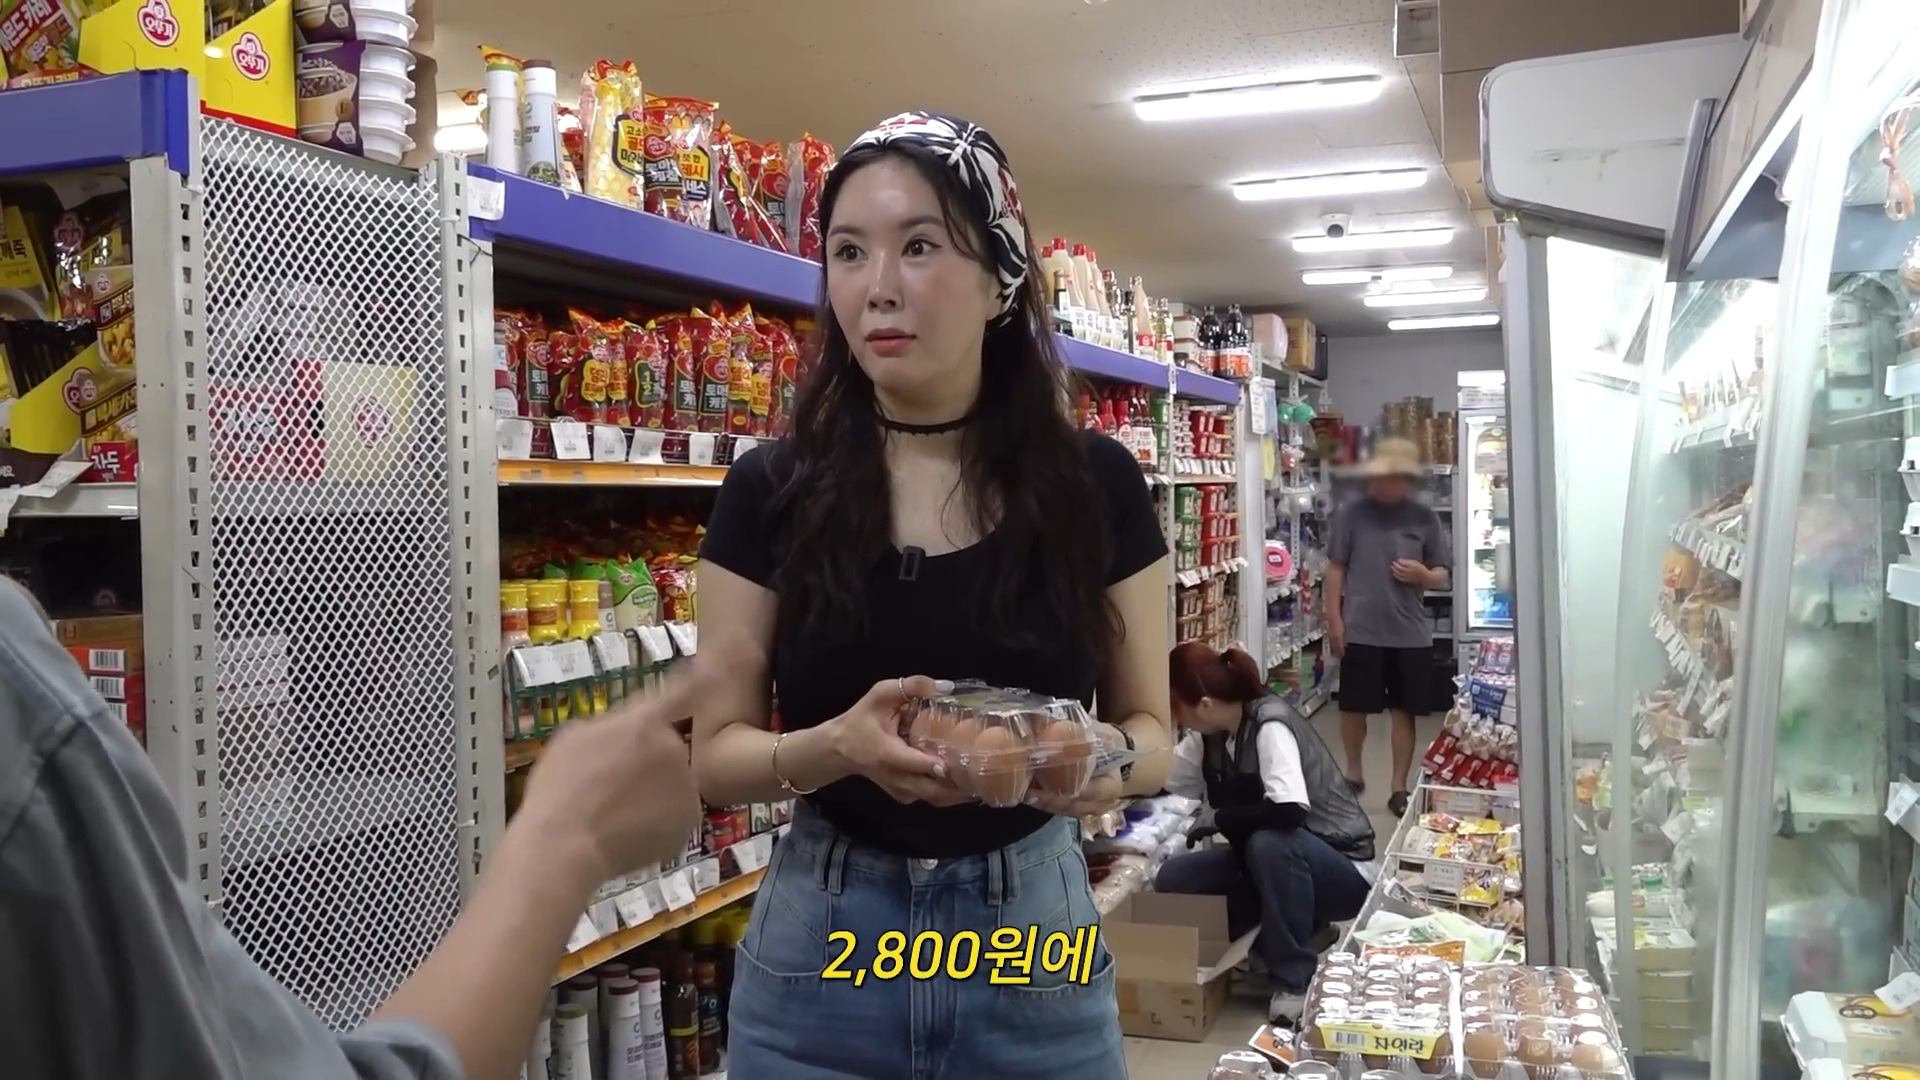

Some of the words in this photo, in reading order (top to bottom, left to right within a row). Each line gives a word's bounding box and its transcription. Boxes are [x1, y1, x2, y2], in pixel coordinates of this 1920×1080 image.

[144, 16, 174, 38] 오뚜기
[239, 52, 265, 73] 오뚜기
[91, 451, 121, 475] 자두
